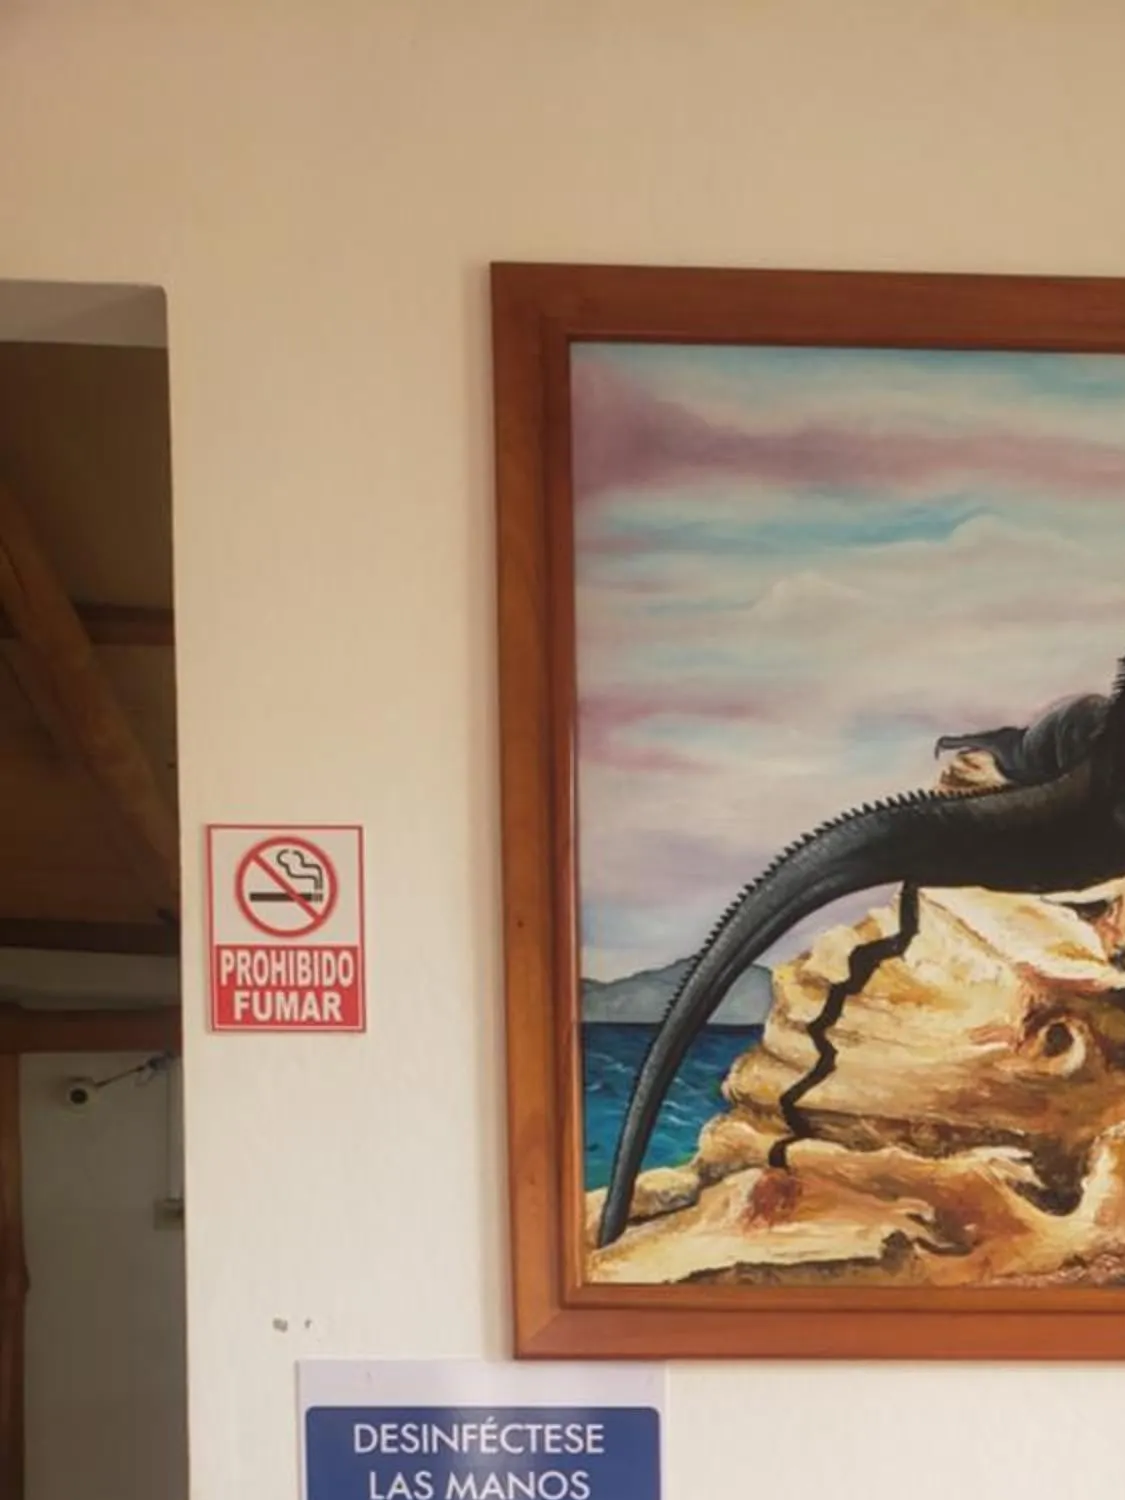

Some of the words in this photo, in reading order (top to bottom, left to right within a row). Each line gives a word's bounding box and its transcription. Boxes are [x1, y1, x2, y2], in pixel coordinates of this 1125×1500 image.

[220, 949, 354, 987] PROHIBIDO
[233, 990, 343, 1022] FUMAR
[353, 1417, 605, 1454] DESINFÉCTESE
[369, 1470, 434, 1500] LAS
[445, 1470, 591, 1500] MANOS
